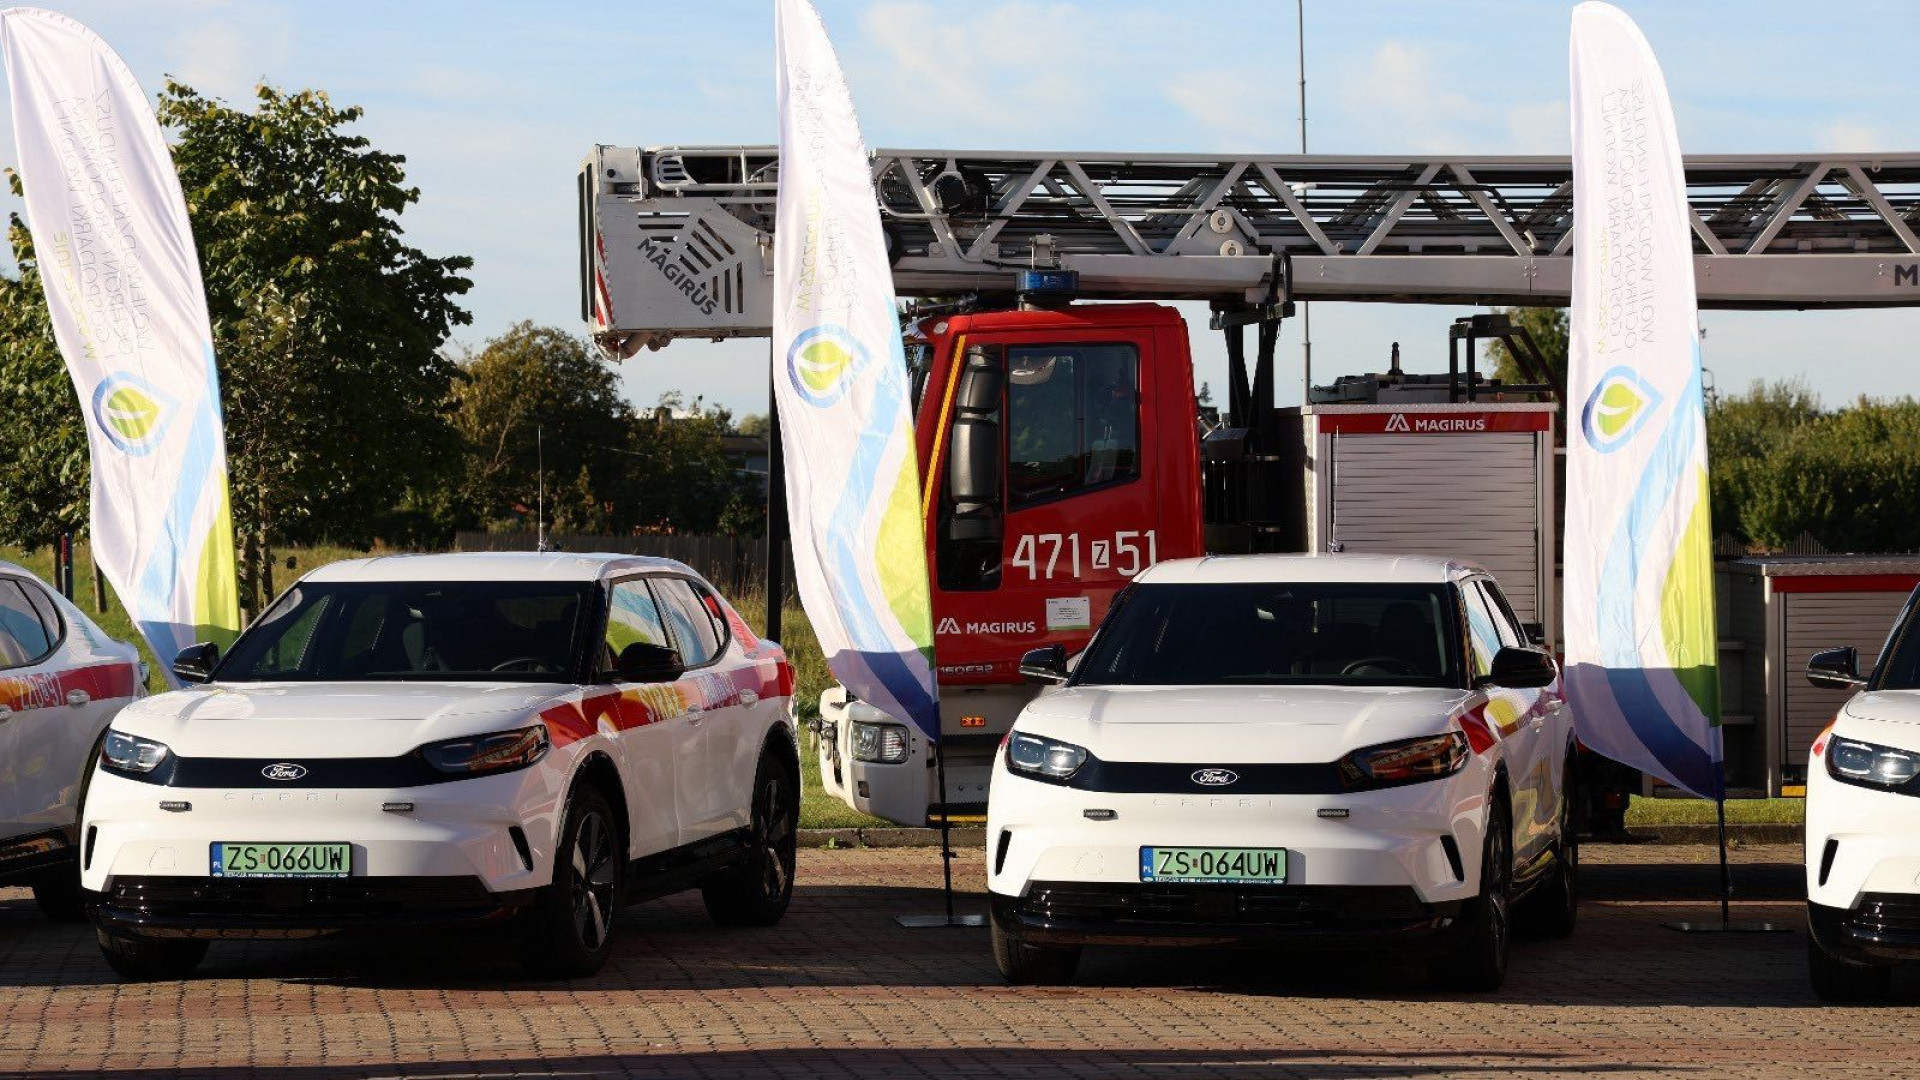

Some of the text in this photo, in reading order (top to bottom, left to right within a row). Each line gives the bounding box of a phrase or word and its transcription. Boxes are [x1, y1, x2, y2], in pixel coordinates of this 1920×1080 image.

[636, 237, 719, 316] MAGIRUS
[1415, 419, 1486, 432] MAGIRUS
[966, 621, 1037, 634] MAGIRUS
[227, 846, 343, 871] ZS 066UW
[1158, 851, 1278, 876] ZS 064UW
[1143, 865, 1152, 873] PL
